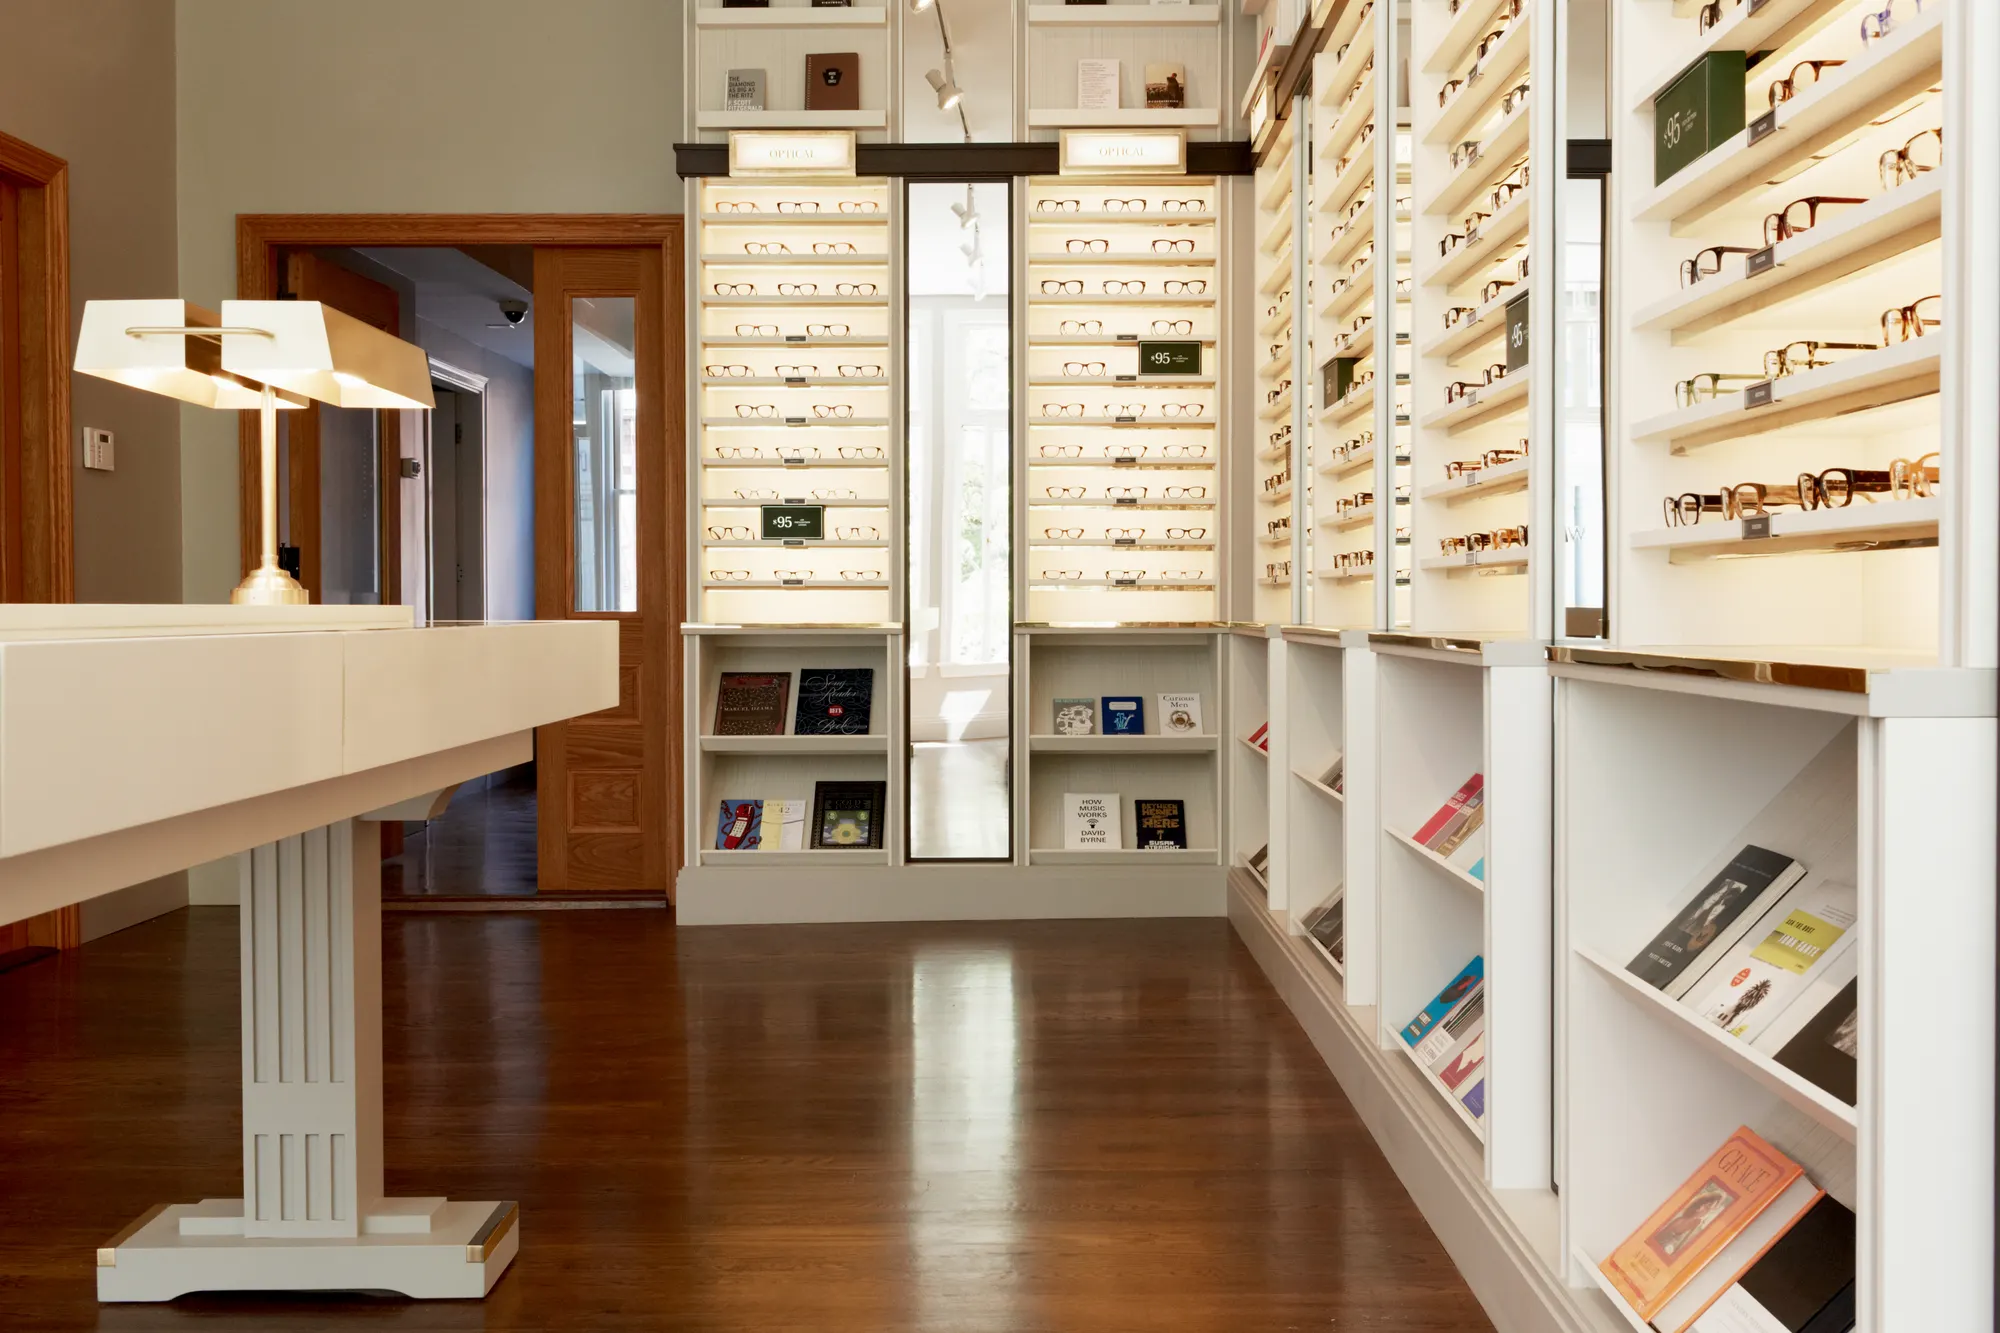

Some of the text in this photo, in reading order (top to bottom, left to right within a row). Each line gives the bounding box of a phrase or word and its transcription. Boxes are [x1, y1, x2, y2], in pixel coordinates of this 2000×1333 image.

[769, 149, 814, 158] OPTICAL
[1099, 146, 1144, 156] OPTICAL
[1150, 352, 1170, 365] $95
[772, 516, 793, 528] $95
[1718, 1148, 1771, 1194] GRACE
